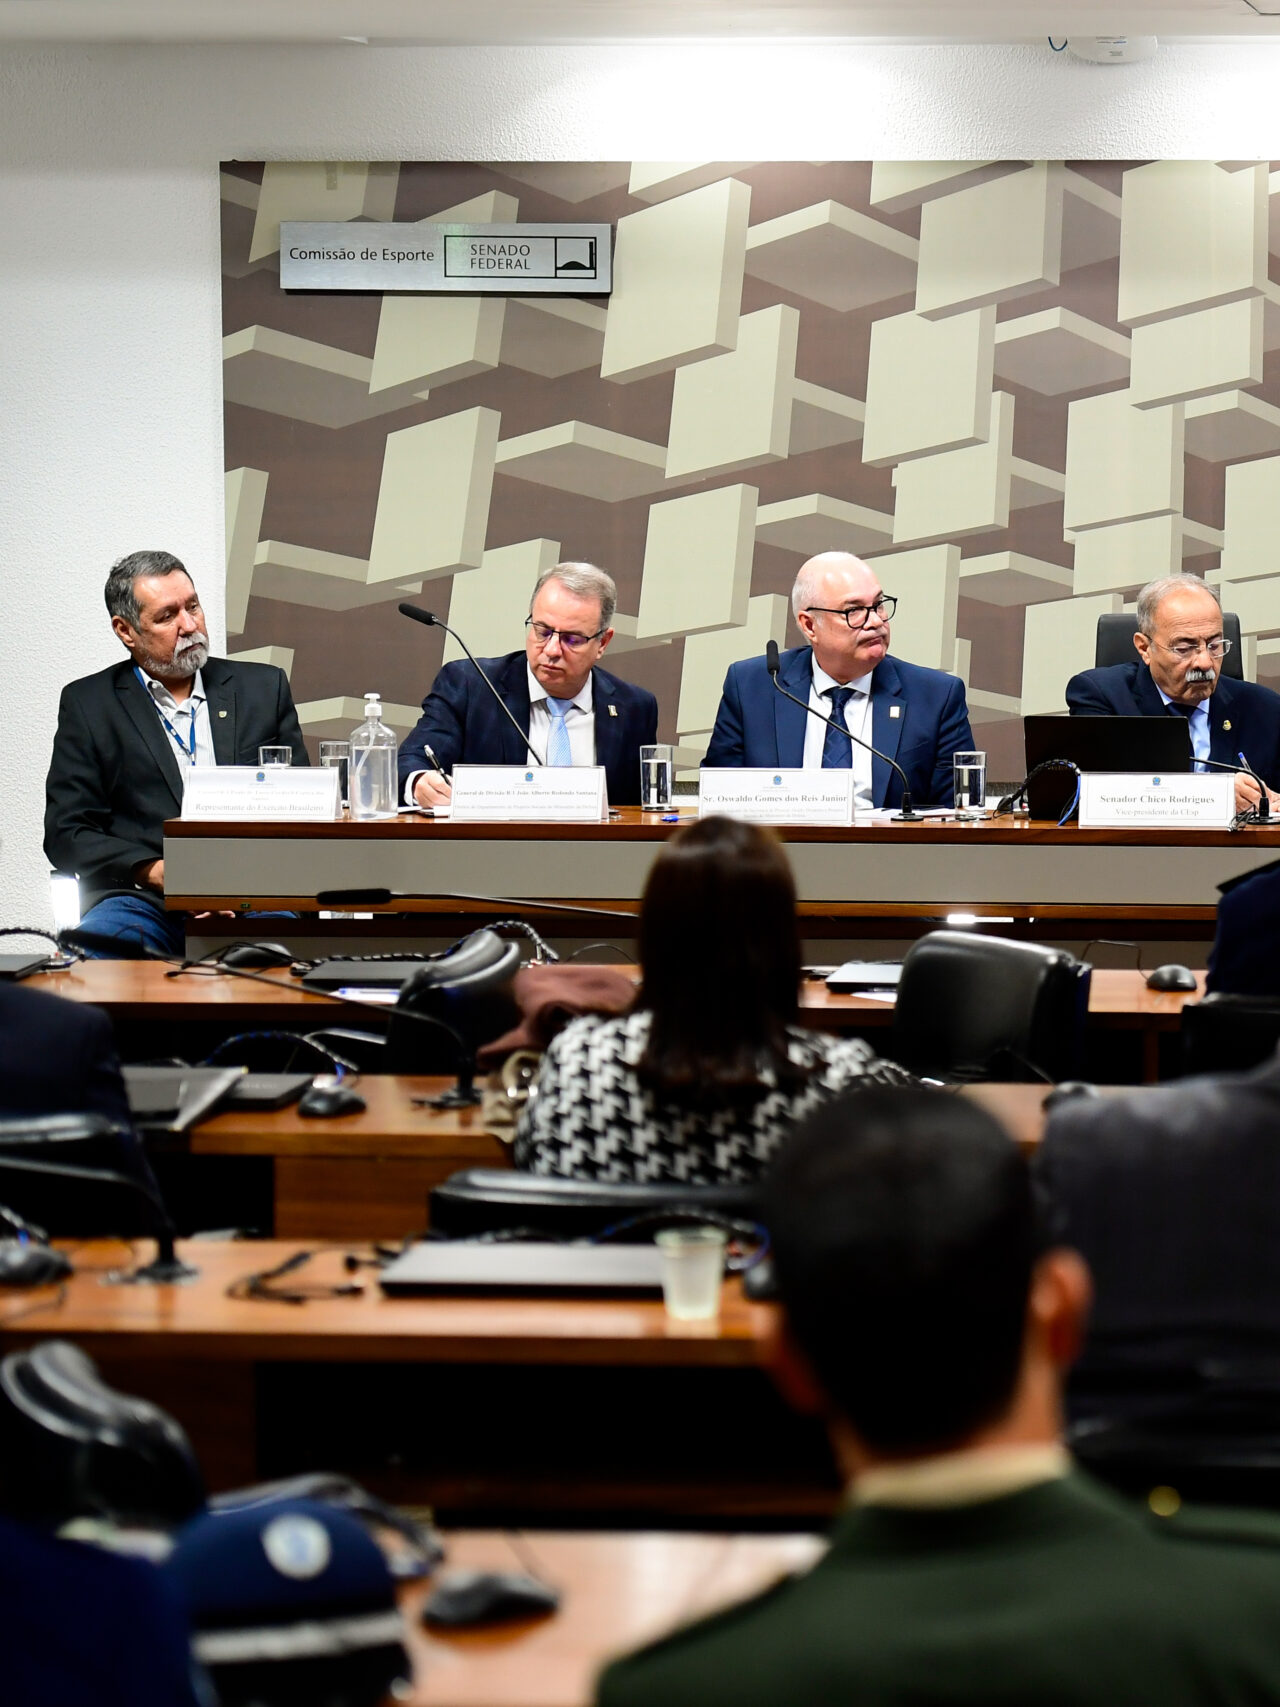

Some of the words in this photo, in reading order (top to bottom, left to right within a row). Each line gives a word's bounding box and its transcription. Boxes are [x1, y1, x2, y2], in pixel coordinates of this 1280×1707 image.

[289, 247, 355, 261] Comissão
[360, 247, 378, 261] de
[382, 248, 434, 264] Esporte
[470, 244, 531, 257] SENADO
[470, 257, 532, 270] FEDERAL
[703, 794, 715, 803] Sr.
[717, 794, 753, 803] Oswaldo
[754, 794, 782, 803] Gomes
[784, 794, 799, 803] dos
[800, 794, 819, 803] Reis
[1100, 795, 1138, 803] Senador
[1140, 795, 1166, 803] Chico
[1169, 795, 1215, 804] Rodrigues
[1115, 808, 1168, 817] Vice-presidente
[1170, 808, 1179, 816] da
